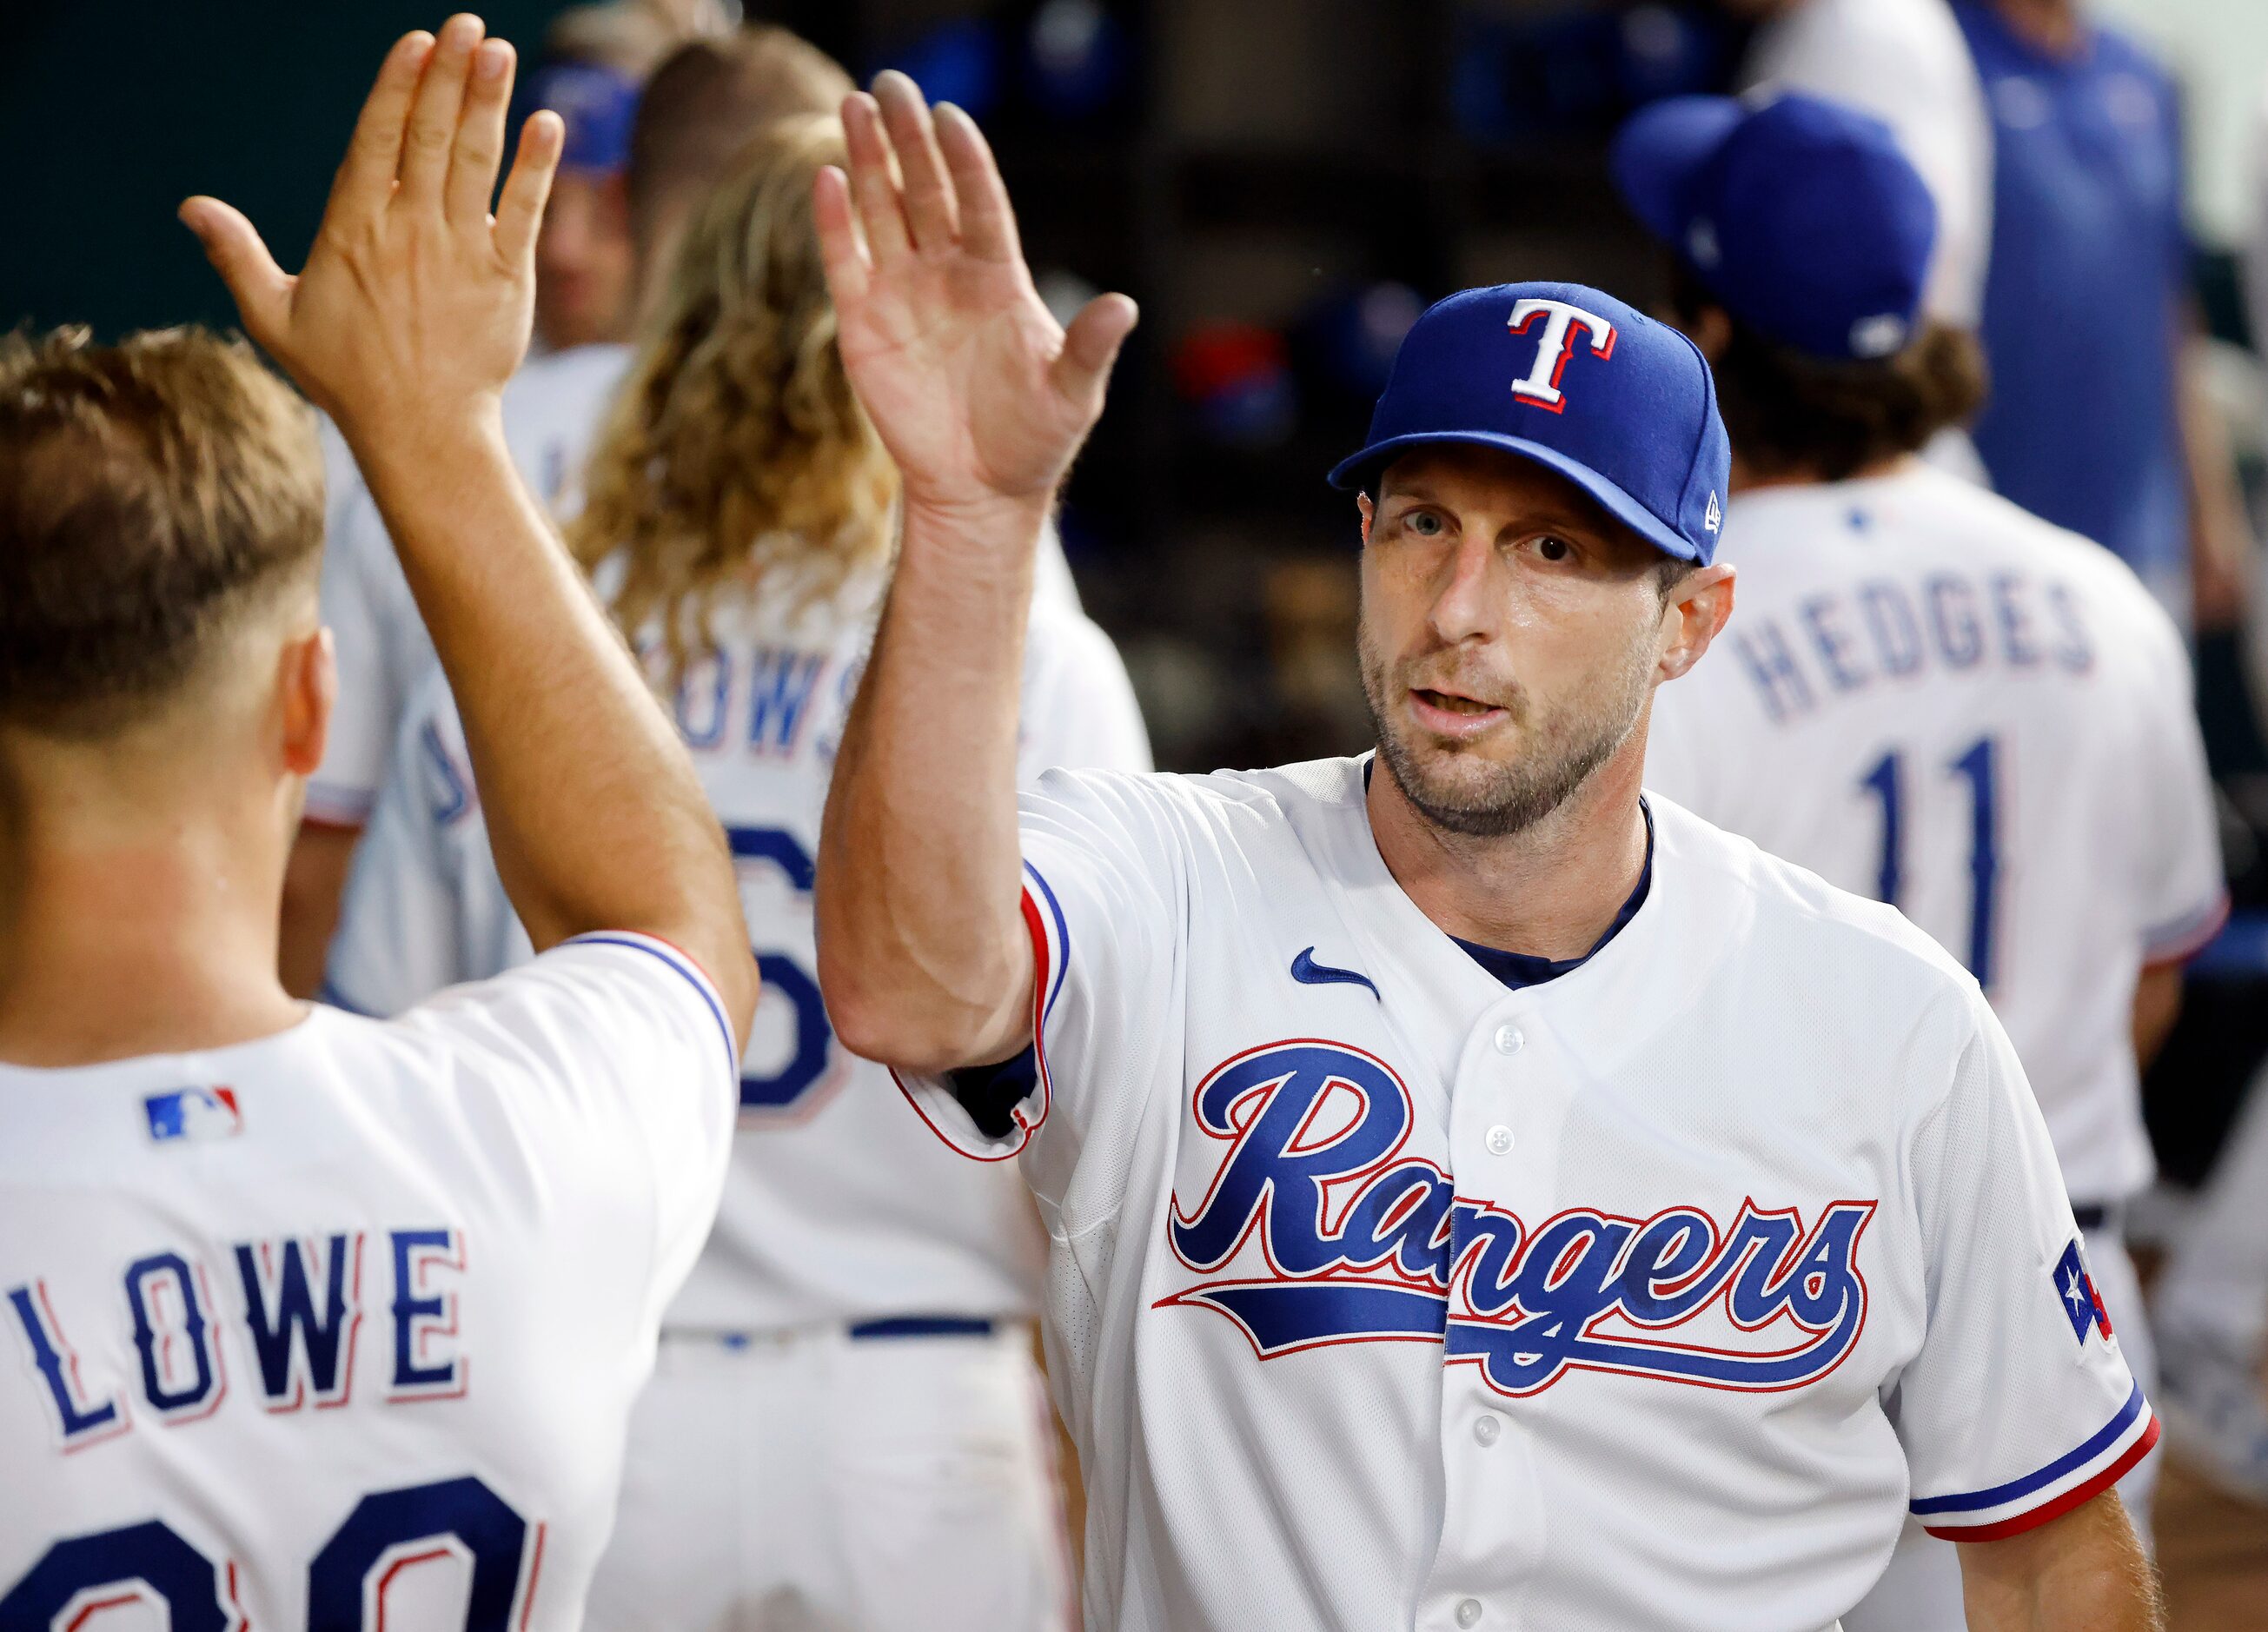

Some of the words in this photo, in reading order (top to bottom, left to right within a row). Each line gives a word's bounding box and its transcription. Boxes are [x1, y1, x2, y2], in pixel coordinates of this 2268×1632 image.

[1507, 298, 1617, 415] T
[1731, 569, 2099, 725] HEDGES
[1853, 728, 2019, 1004] 11
[1152, 1038, 1878, 1397] Rangers
[7, 1227, 469, 1455] LOWE
